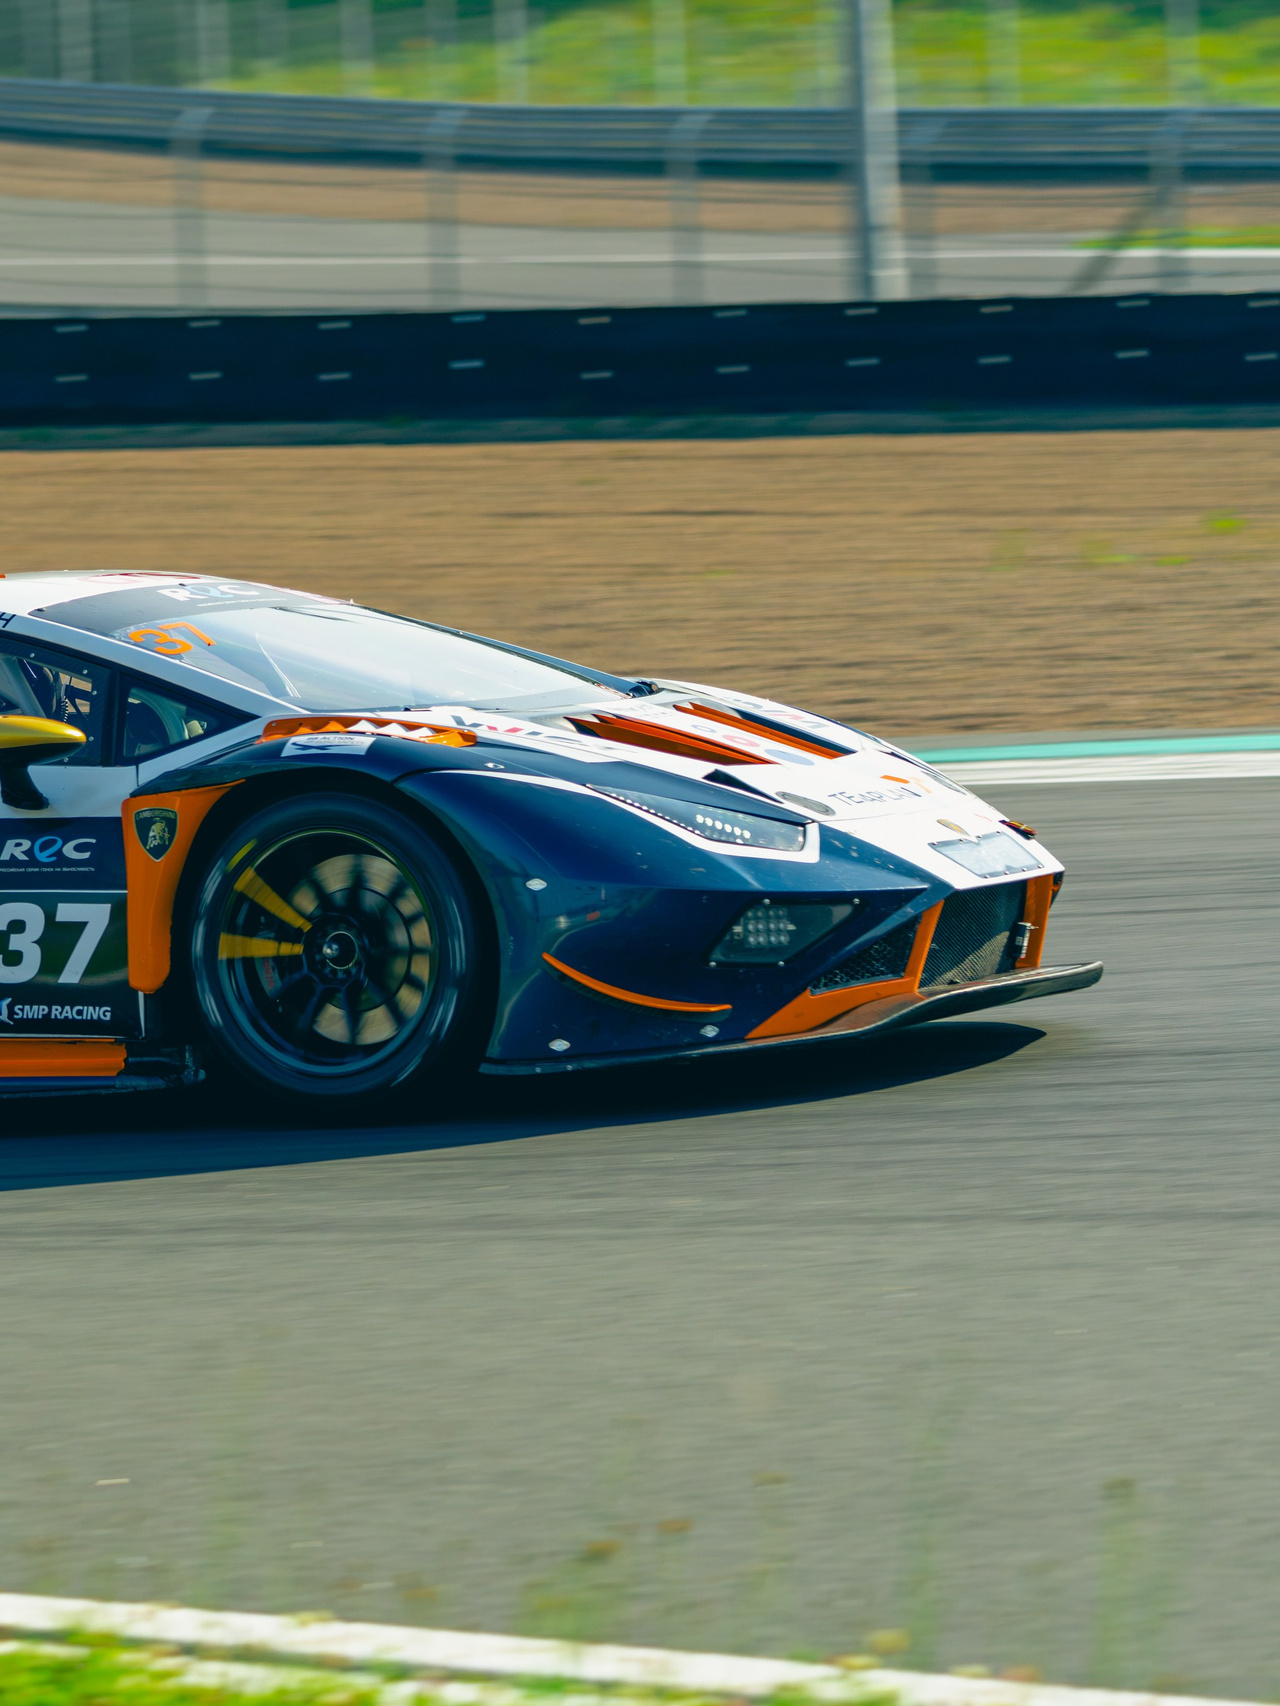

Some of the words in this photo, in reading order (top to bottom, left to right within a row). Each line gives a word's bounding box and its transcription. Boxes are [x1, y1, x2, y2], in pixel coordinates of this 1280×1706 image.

[128, 621, 217, 655] 37
[13, 1005, 49, 1019] SMP
[50, 1006, 112, 1021] RACING
